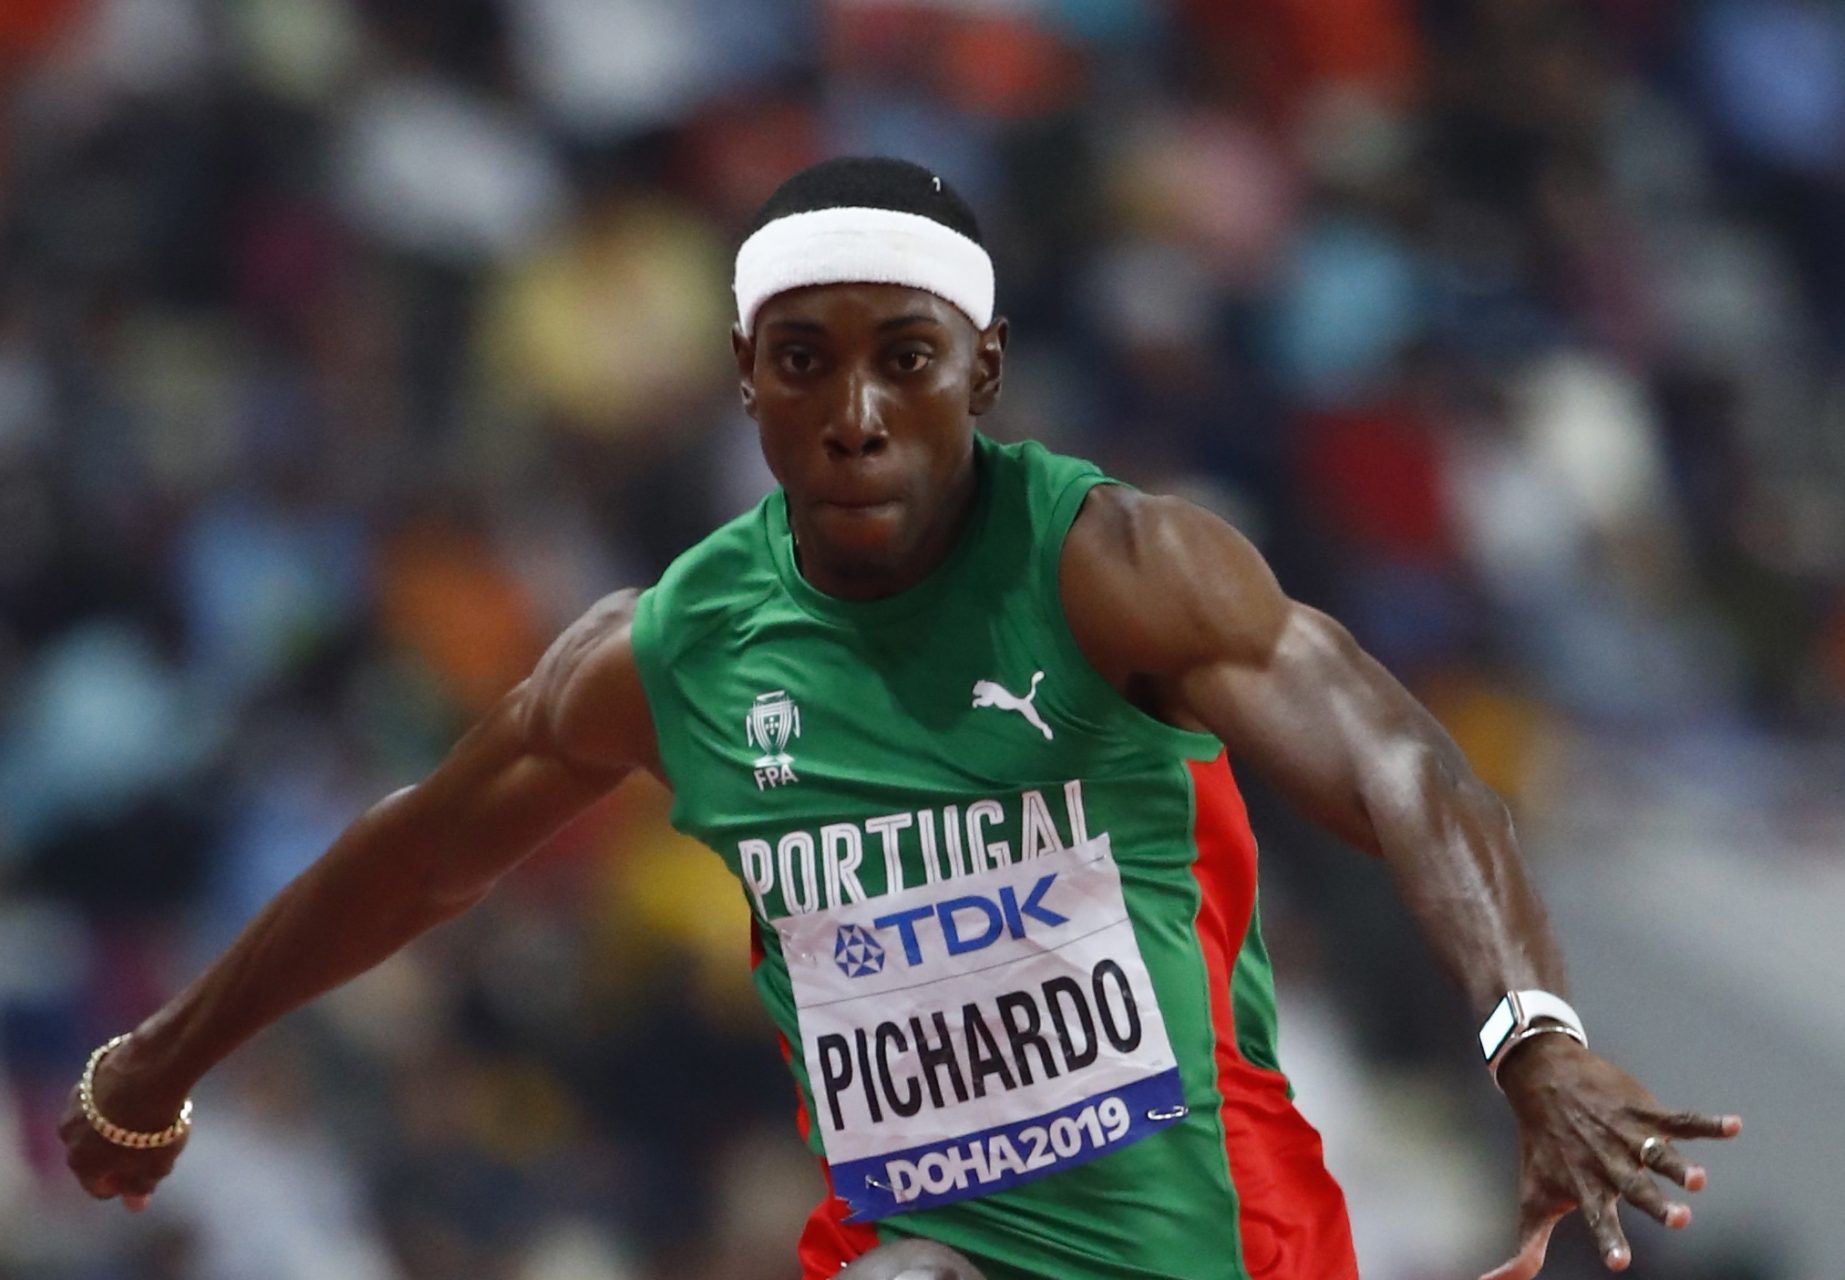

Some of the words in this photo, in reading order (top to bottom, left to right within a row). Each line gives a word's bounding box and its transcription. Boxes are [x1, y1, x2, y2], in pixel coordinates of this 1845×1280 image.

[754, 763, 799, 792] FPA
[874, 872, 1070, 967] TDK
[817, 958, 1142, 1131] PICHARDO
